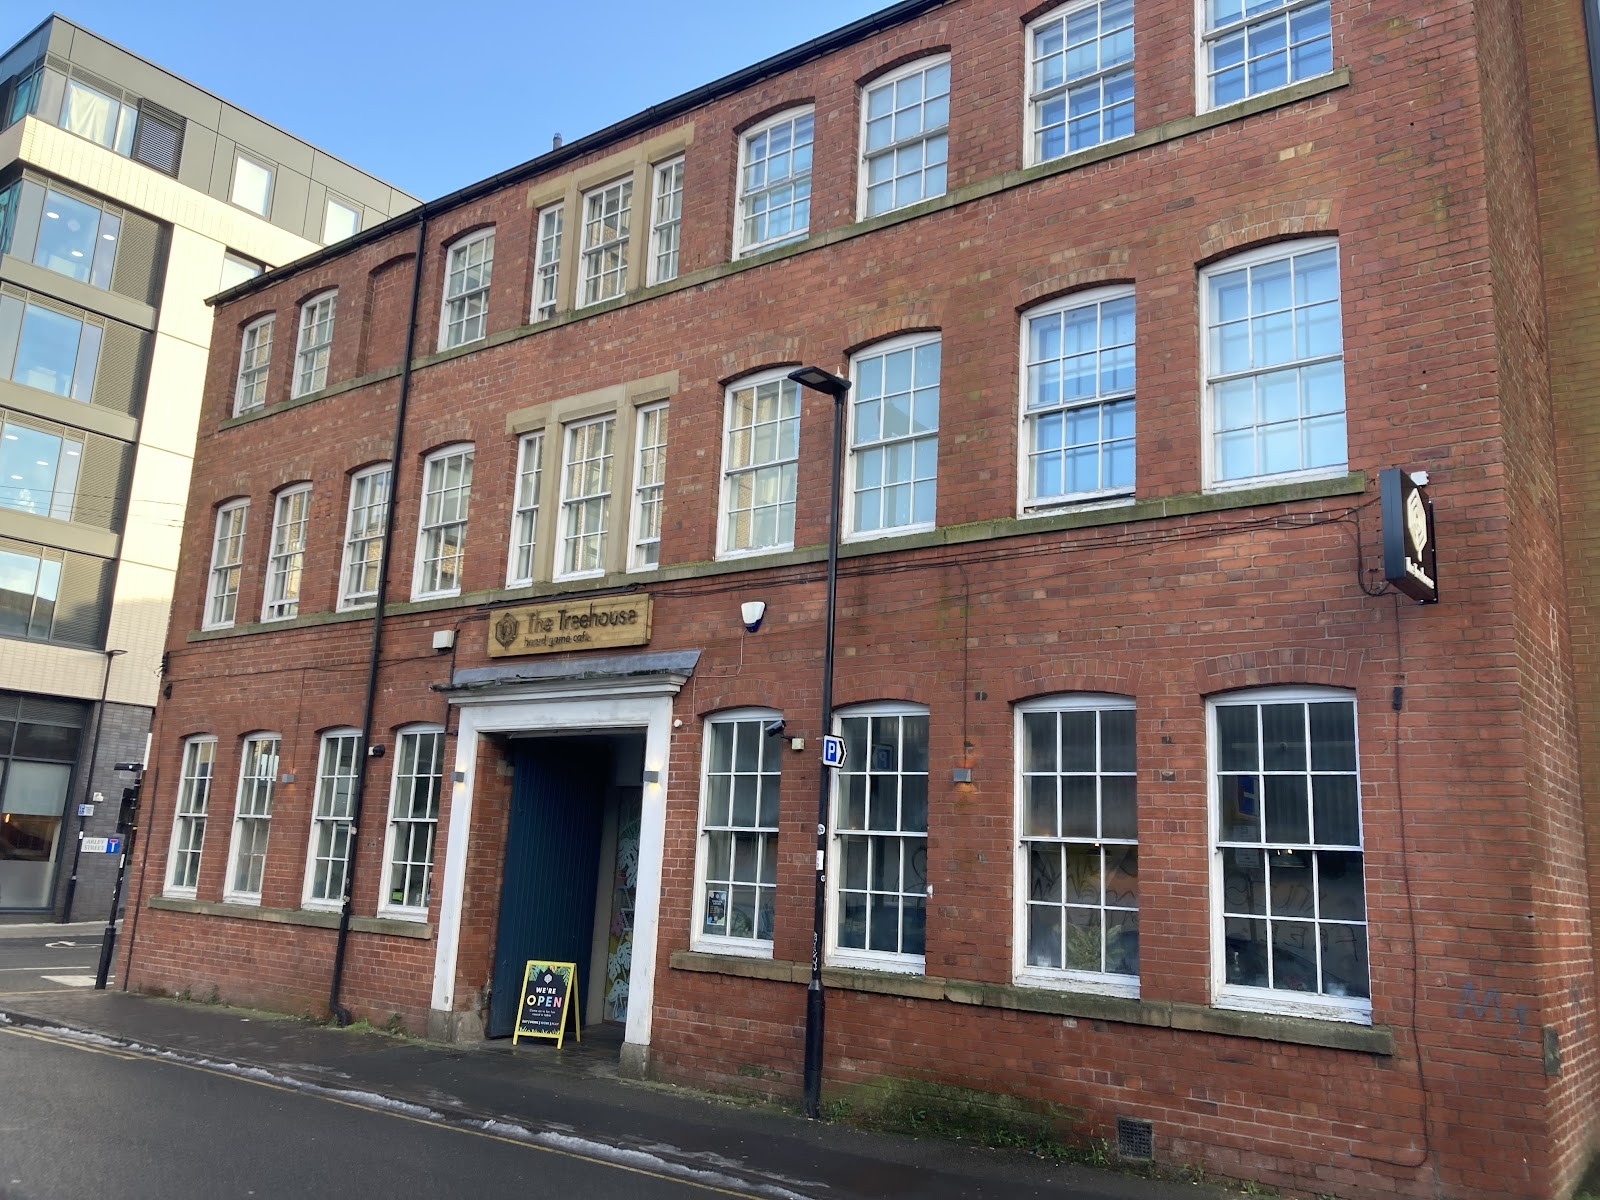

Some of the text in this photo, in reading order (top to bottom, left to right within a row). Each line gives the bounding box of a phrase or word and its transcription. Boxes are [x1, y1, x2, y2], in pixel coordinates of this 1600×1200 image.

[527, 603, 638, 633] The Treehouse
[524, 634, 547, 647] board
[548, 635, 571, 647] game
[828, 742, 836, 760] P
[527, 995, 562, 1008] OPEN
